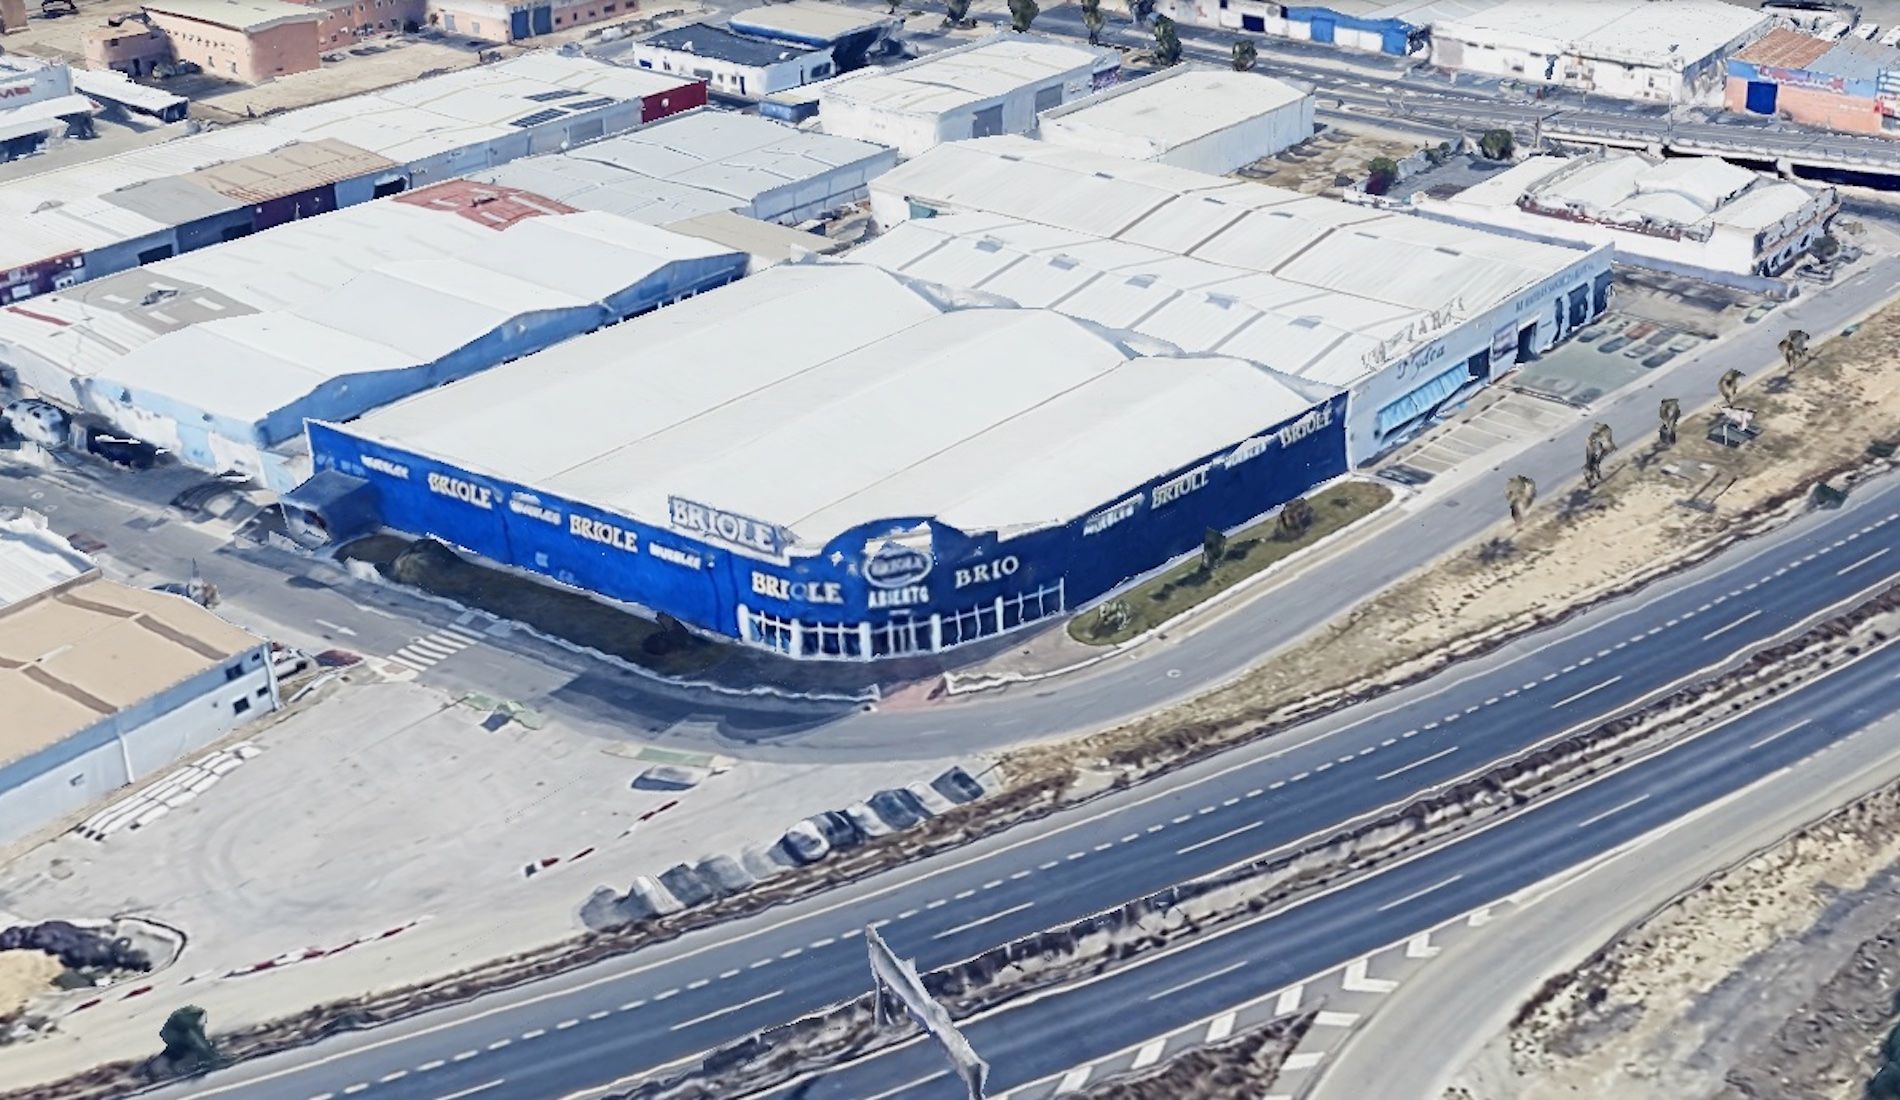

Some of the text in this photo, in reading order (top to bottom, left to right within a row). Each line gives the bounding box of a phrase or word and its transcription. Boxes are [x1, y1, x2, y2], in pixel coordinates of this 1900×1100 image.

[428, 472, 492, 508] BRIOLE
[569, 513, 638, 553] BRIOLE
[672, 499, 775, 553] BRIOLE
[752, 571, 843, 604] BRIOLE
[954, 556, 1020, 589] BRIO
